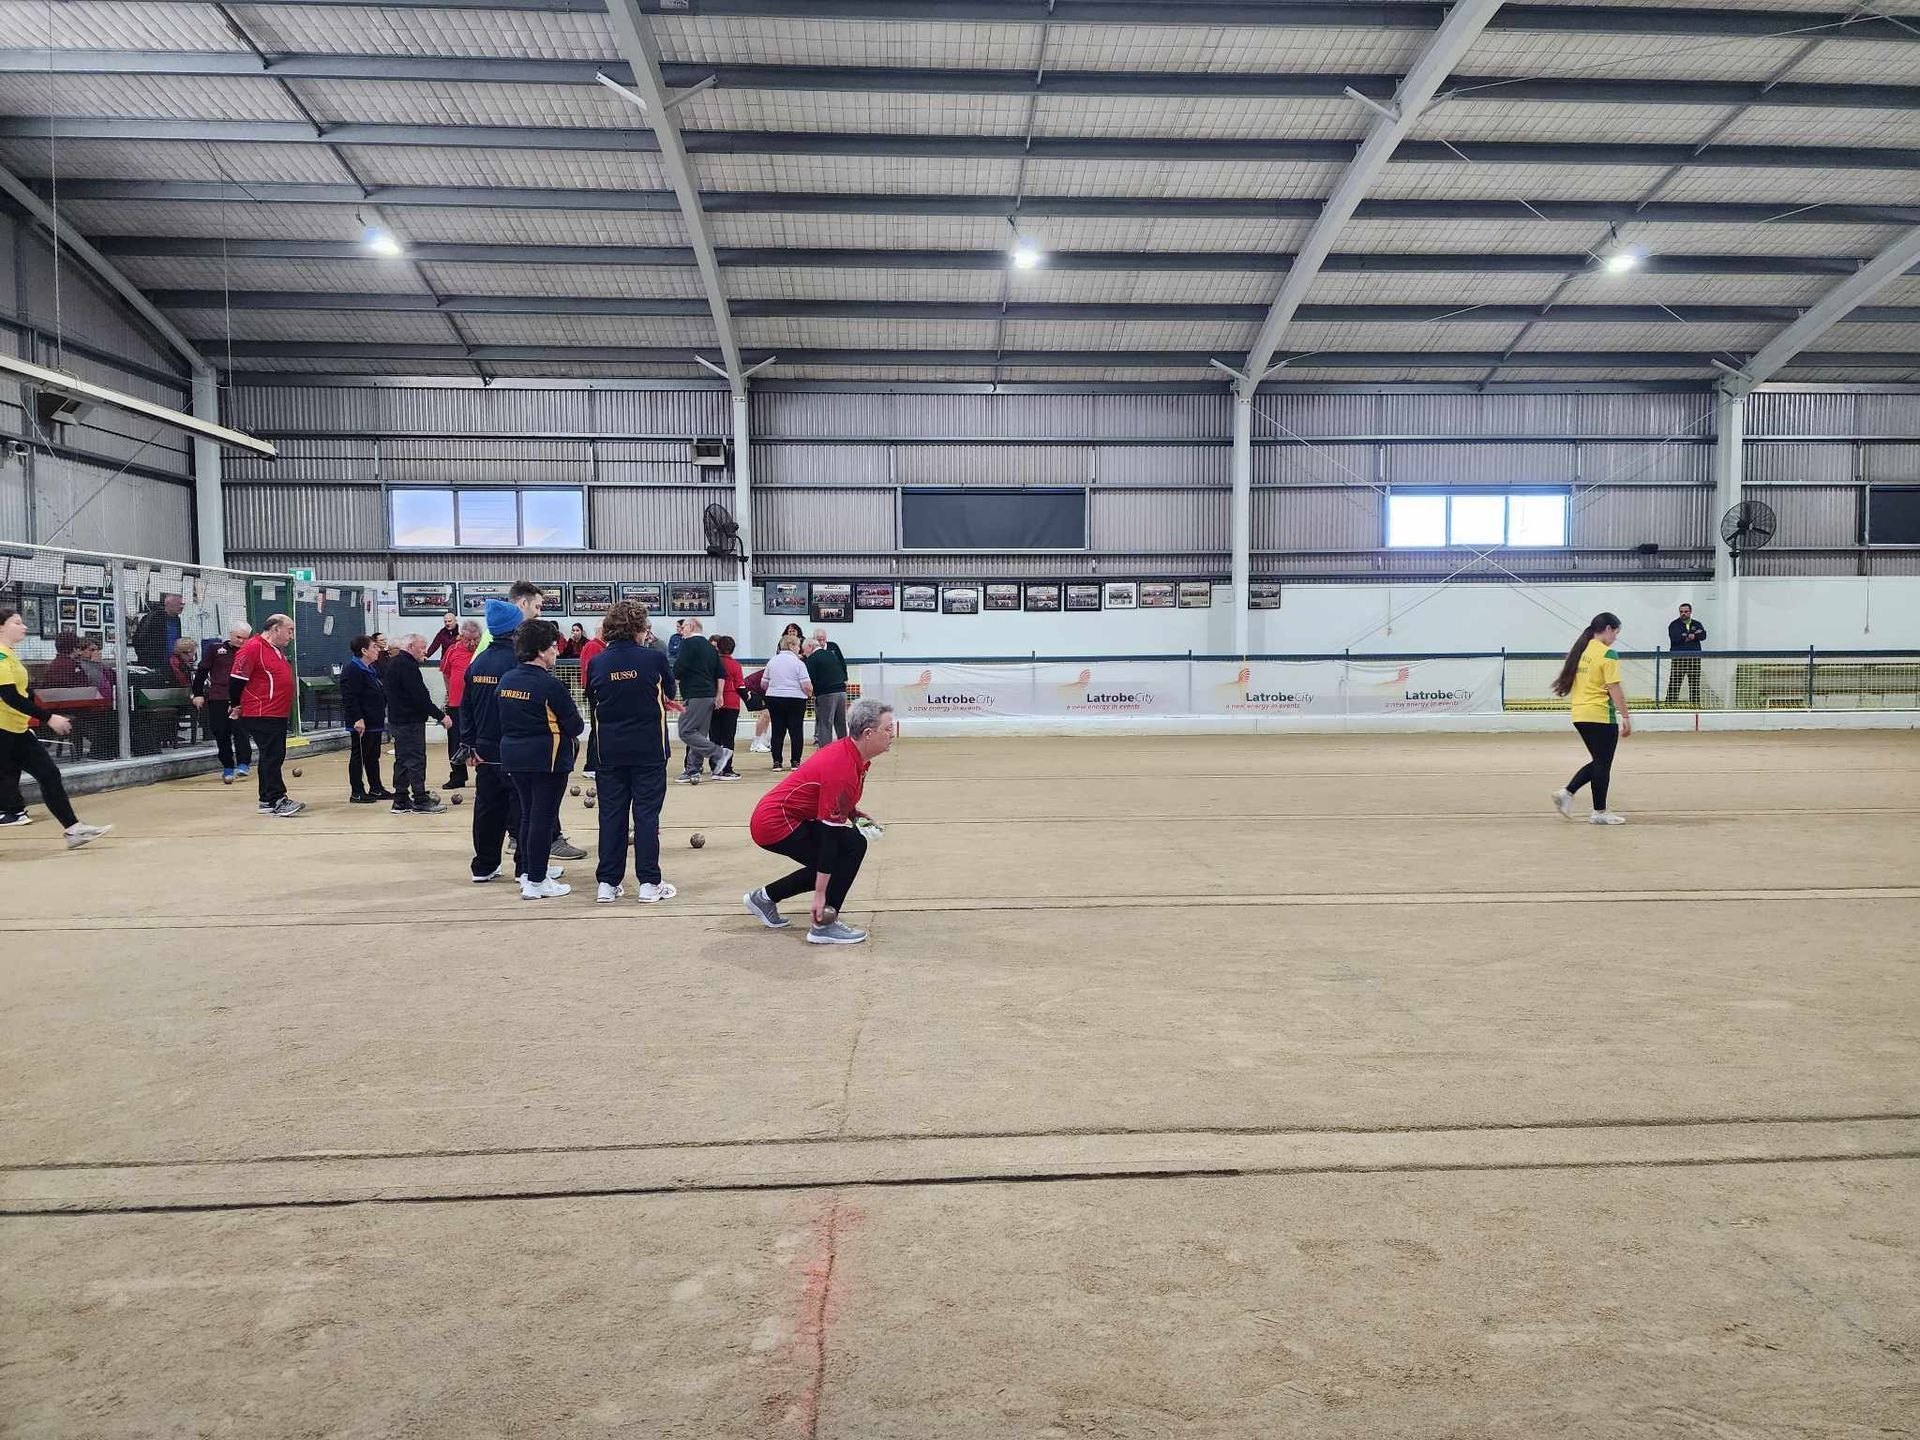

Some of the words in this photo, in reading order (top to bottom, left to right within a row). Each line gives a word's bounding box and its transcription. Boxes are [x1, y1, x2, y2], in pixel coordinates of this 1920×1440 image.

[610, 670, 638, 681] RUSSO
[927, 694, 996, 706] LatrobeCity
[1086, 693, 1155, 704] LatrobeCity
[1245, 692, 1315, 704] LatrobeCity
[1405, 689, 1474, 700] LatrobeCity
